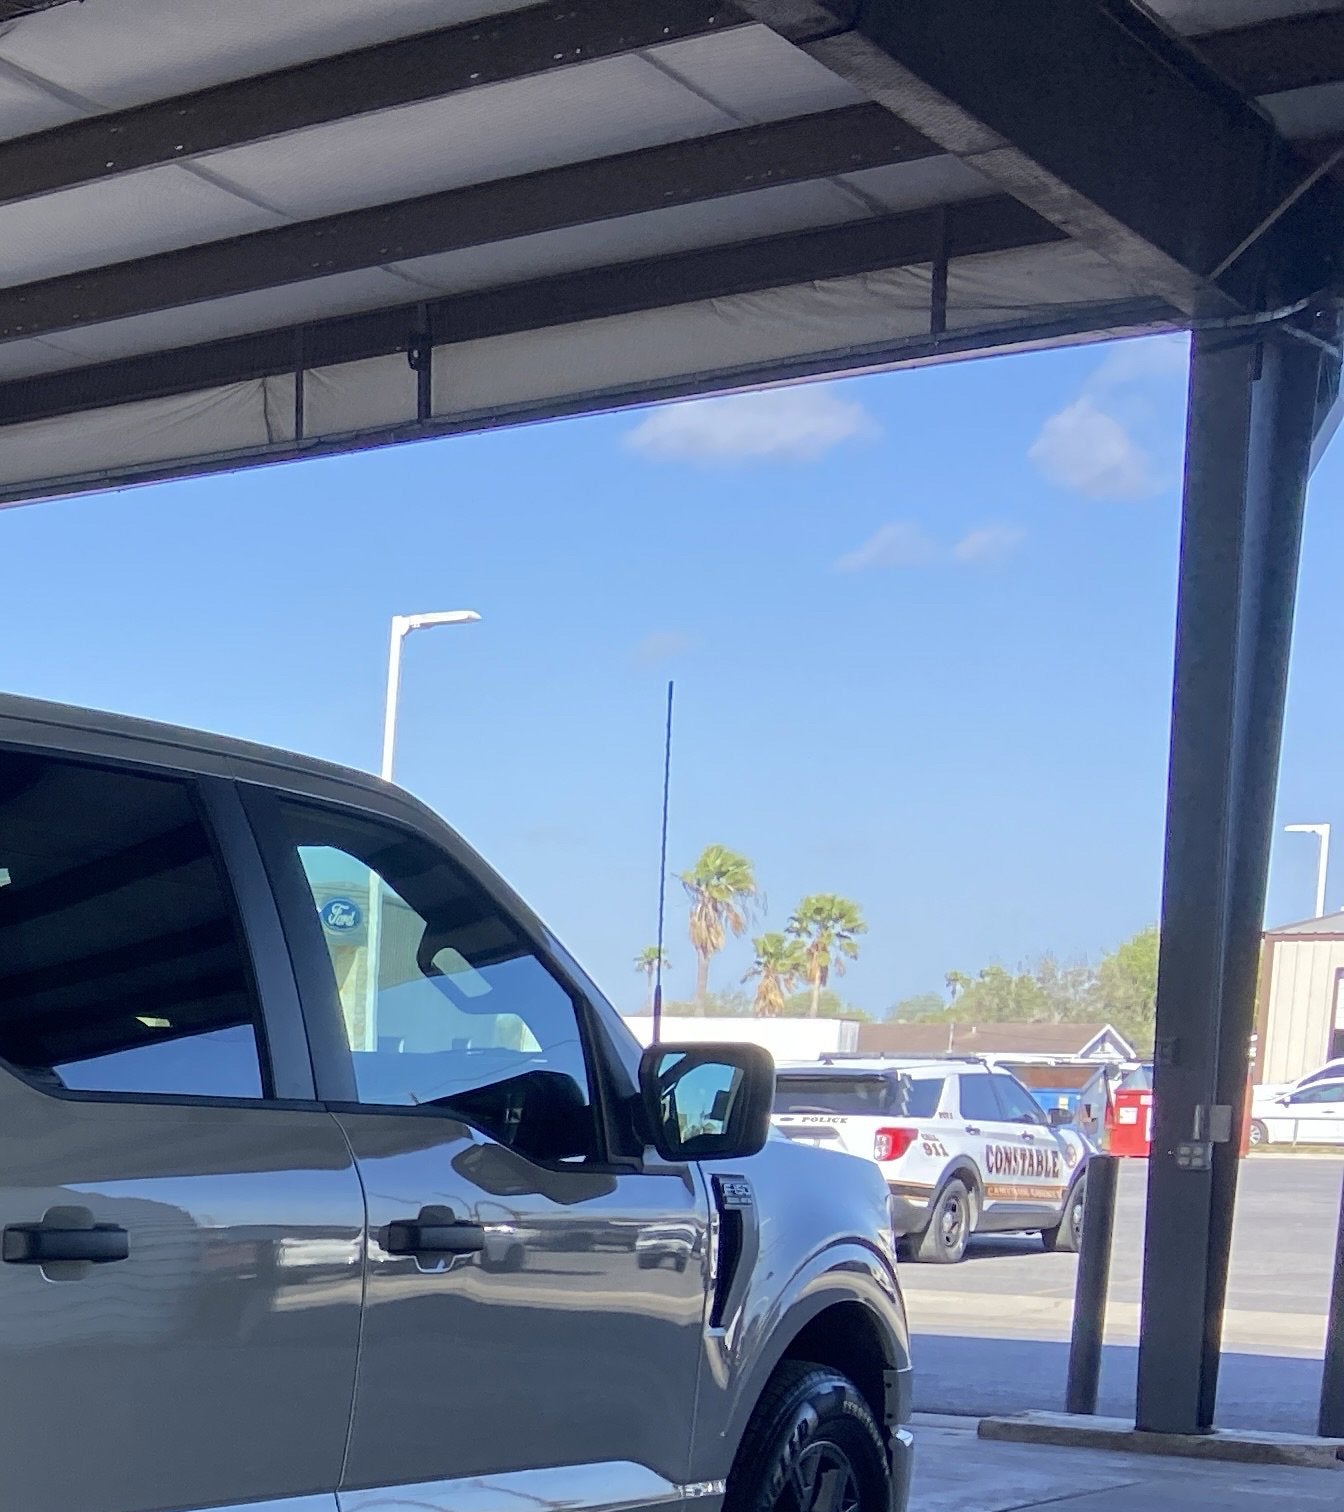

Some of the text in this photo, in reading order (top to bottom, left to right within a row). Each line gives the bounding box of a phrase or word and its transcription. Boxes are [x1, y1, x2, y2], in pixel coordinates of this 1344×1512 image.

[328, 903, 356, 926] Ford
[801, 1116, 848, 1124] POLICE
[923, 1142, 949, 1157] 911
[985, 1144, 1060, 1178] CONSTABLE
